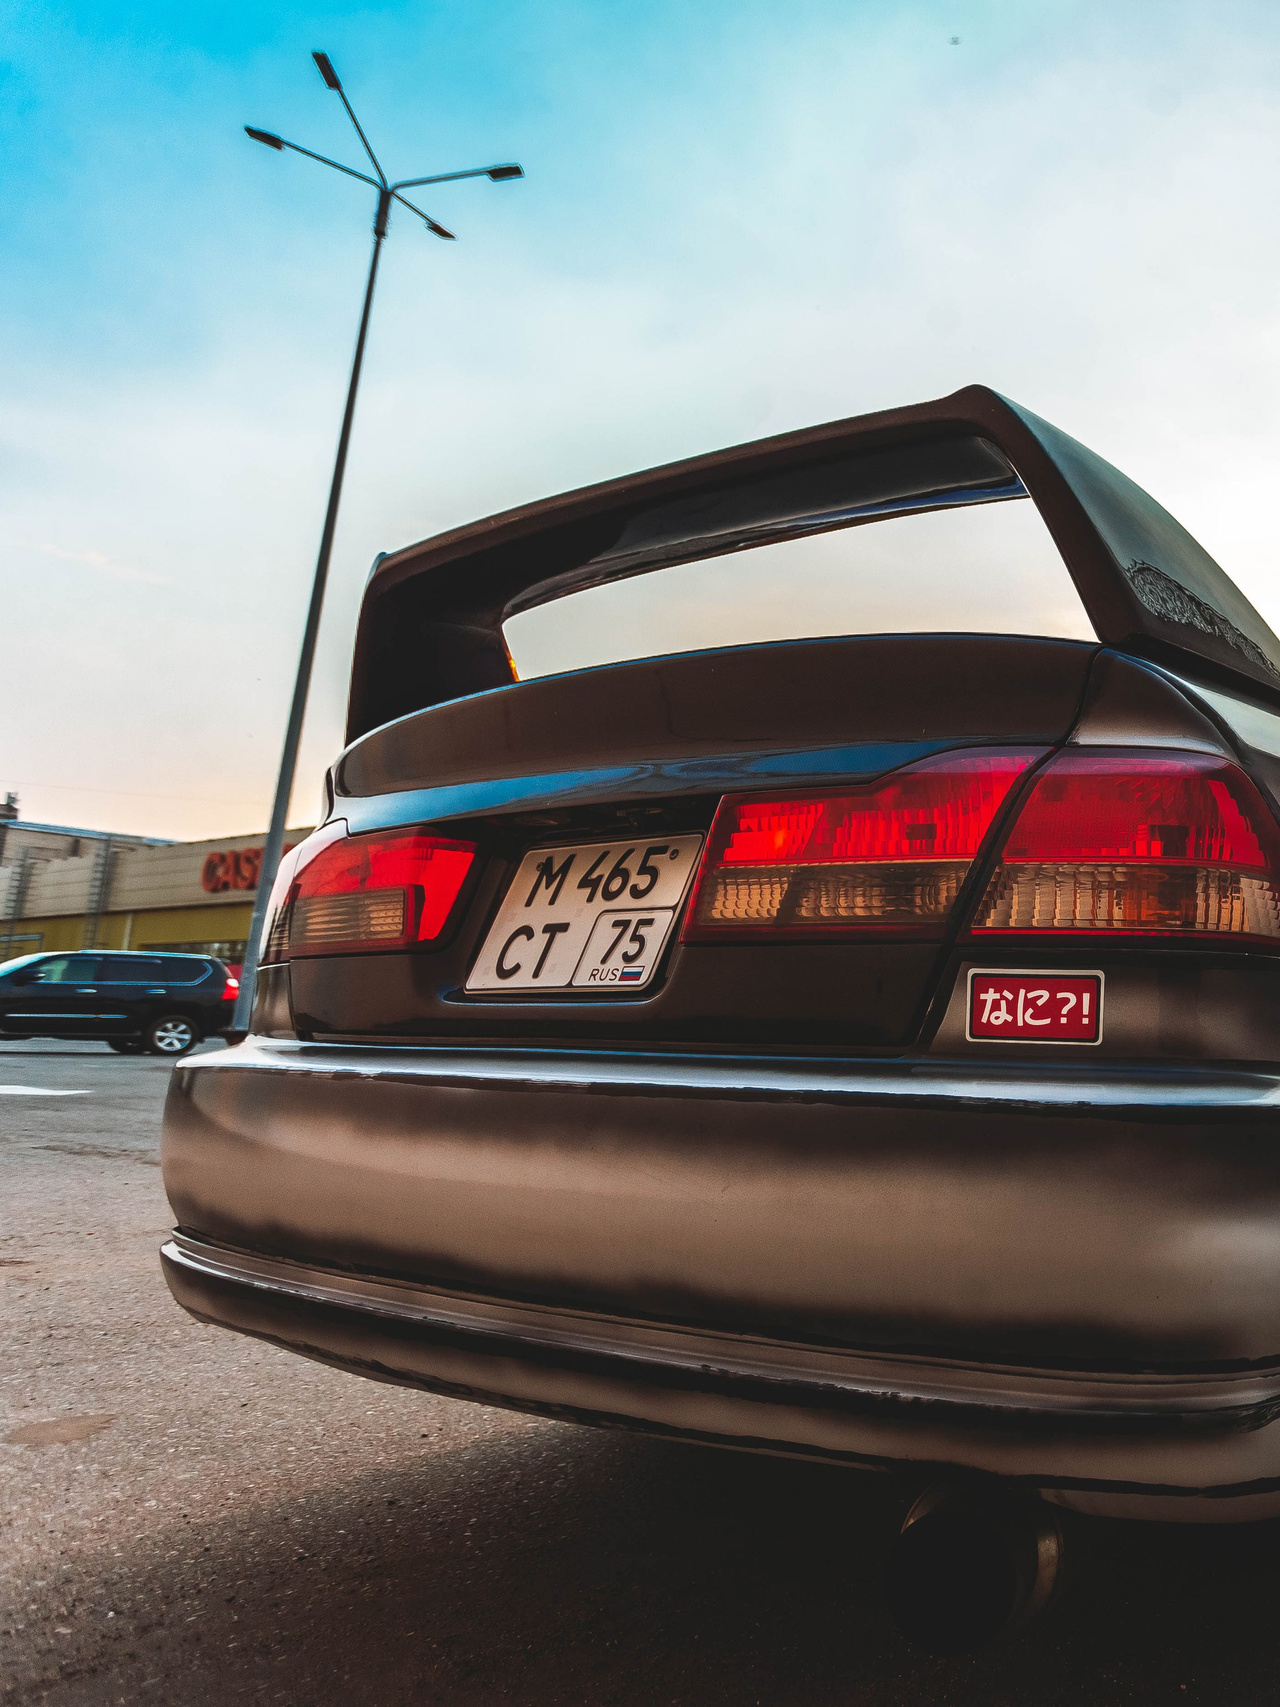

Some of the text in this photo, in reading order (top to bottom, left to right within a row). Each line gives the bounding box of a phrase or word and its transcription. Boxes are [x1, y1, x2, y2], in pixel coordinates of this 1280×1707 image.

[202, 844, 297, 892] CAS
[524, 845, 669, 907] M 465
[496, 922, 570, 980] CT
[600, 918, 654, 965] 75
[588, 967, 619, 982] RUS
